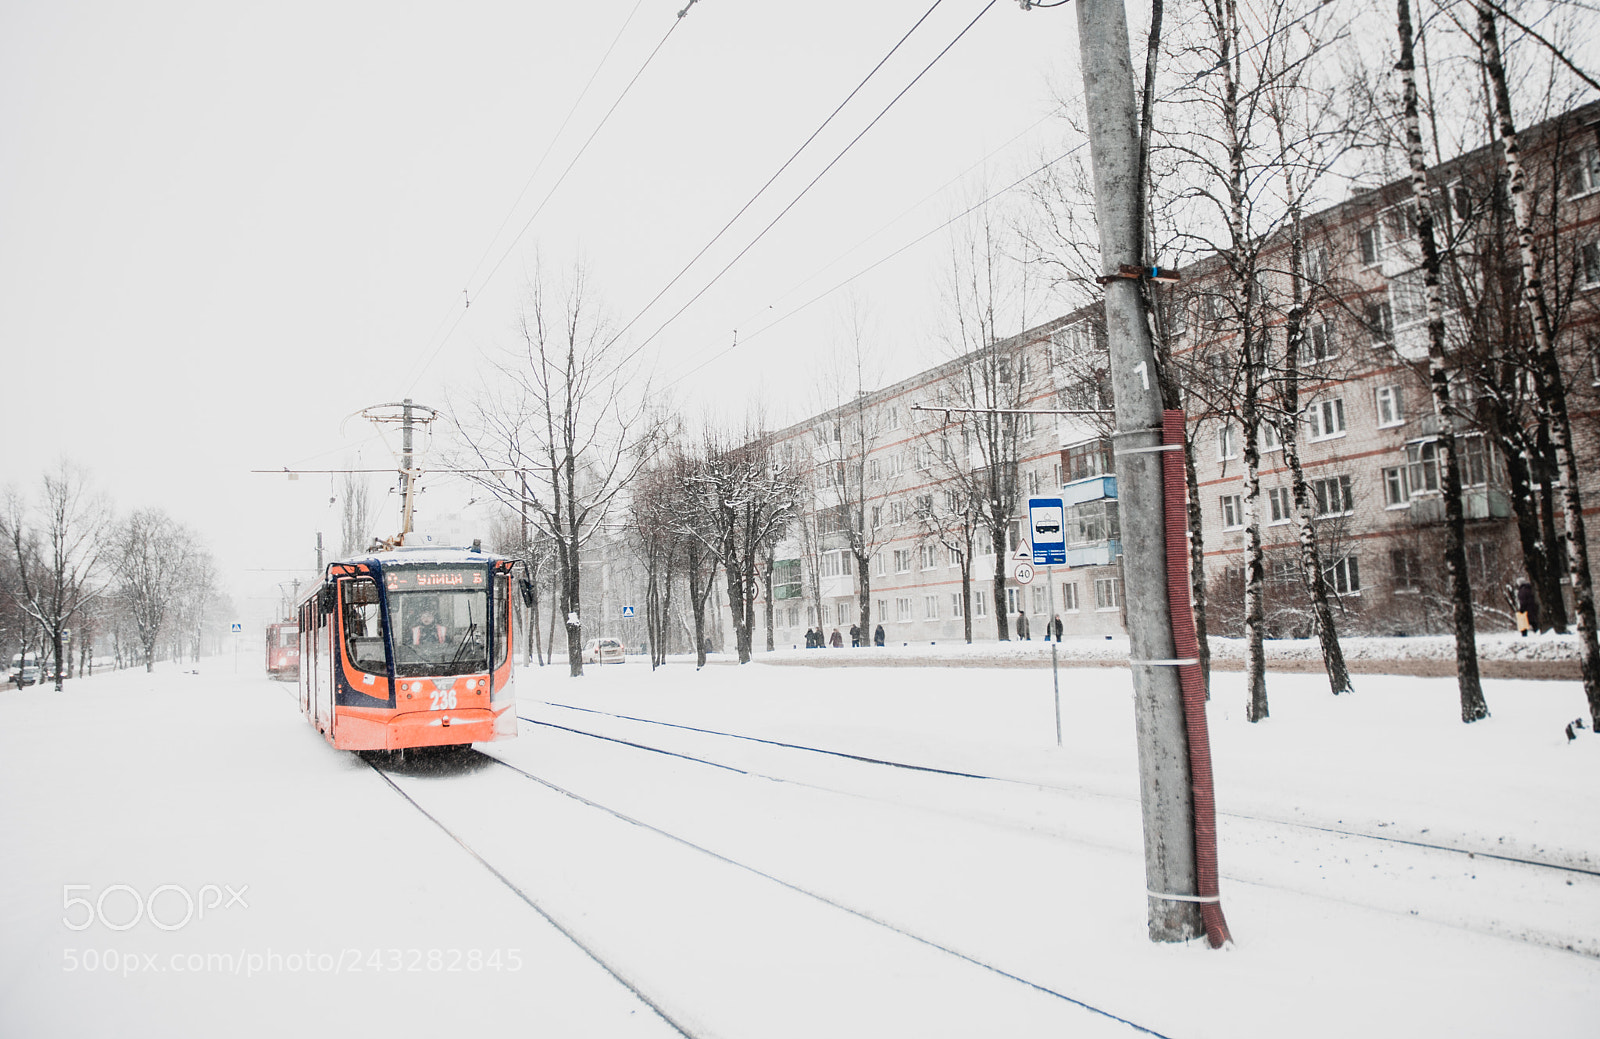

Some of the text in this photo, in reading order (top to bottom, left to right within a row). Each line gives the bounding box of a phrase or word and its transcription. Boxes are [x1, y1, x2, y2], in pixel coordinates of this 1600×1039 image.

[1133, 361, 1149, 390] 1
[1018, 569, 1030, 578] 40
[430, 689, 457, 711] 236
